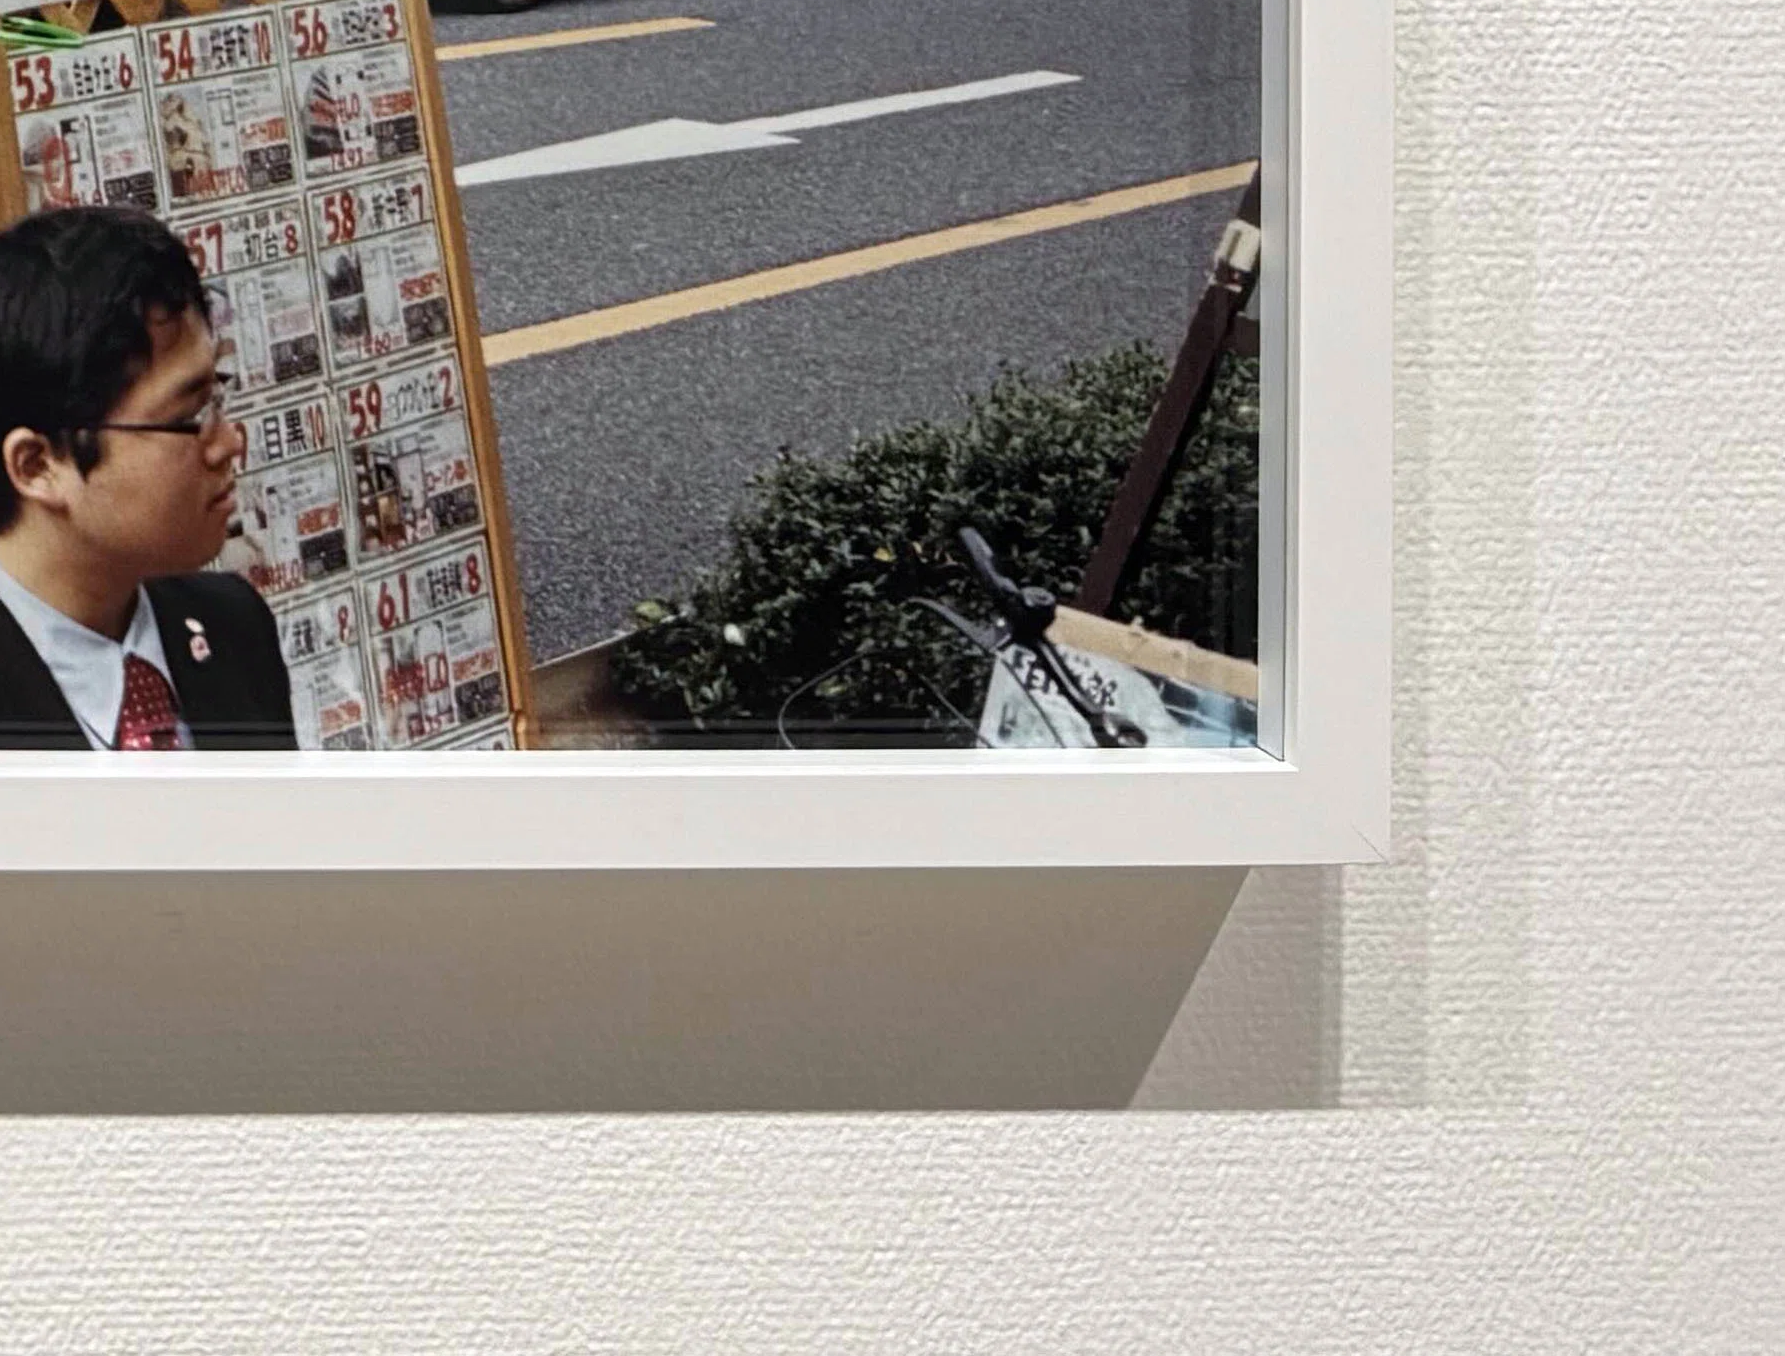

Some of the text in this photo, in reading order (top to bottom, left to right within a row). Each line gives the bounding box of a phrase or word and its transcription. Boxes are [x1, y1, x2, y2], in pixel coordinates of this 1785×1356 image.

[119, 52, 134, 89] 6
[284, 223, 299, 255] 8
[466, 552, 481, 595] 8
